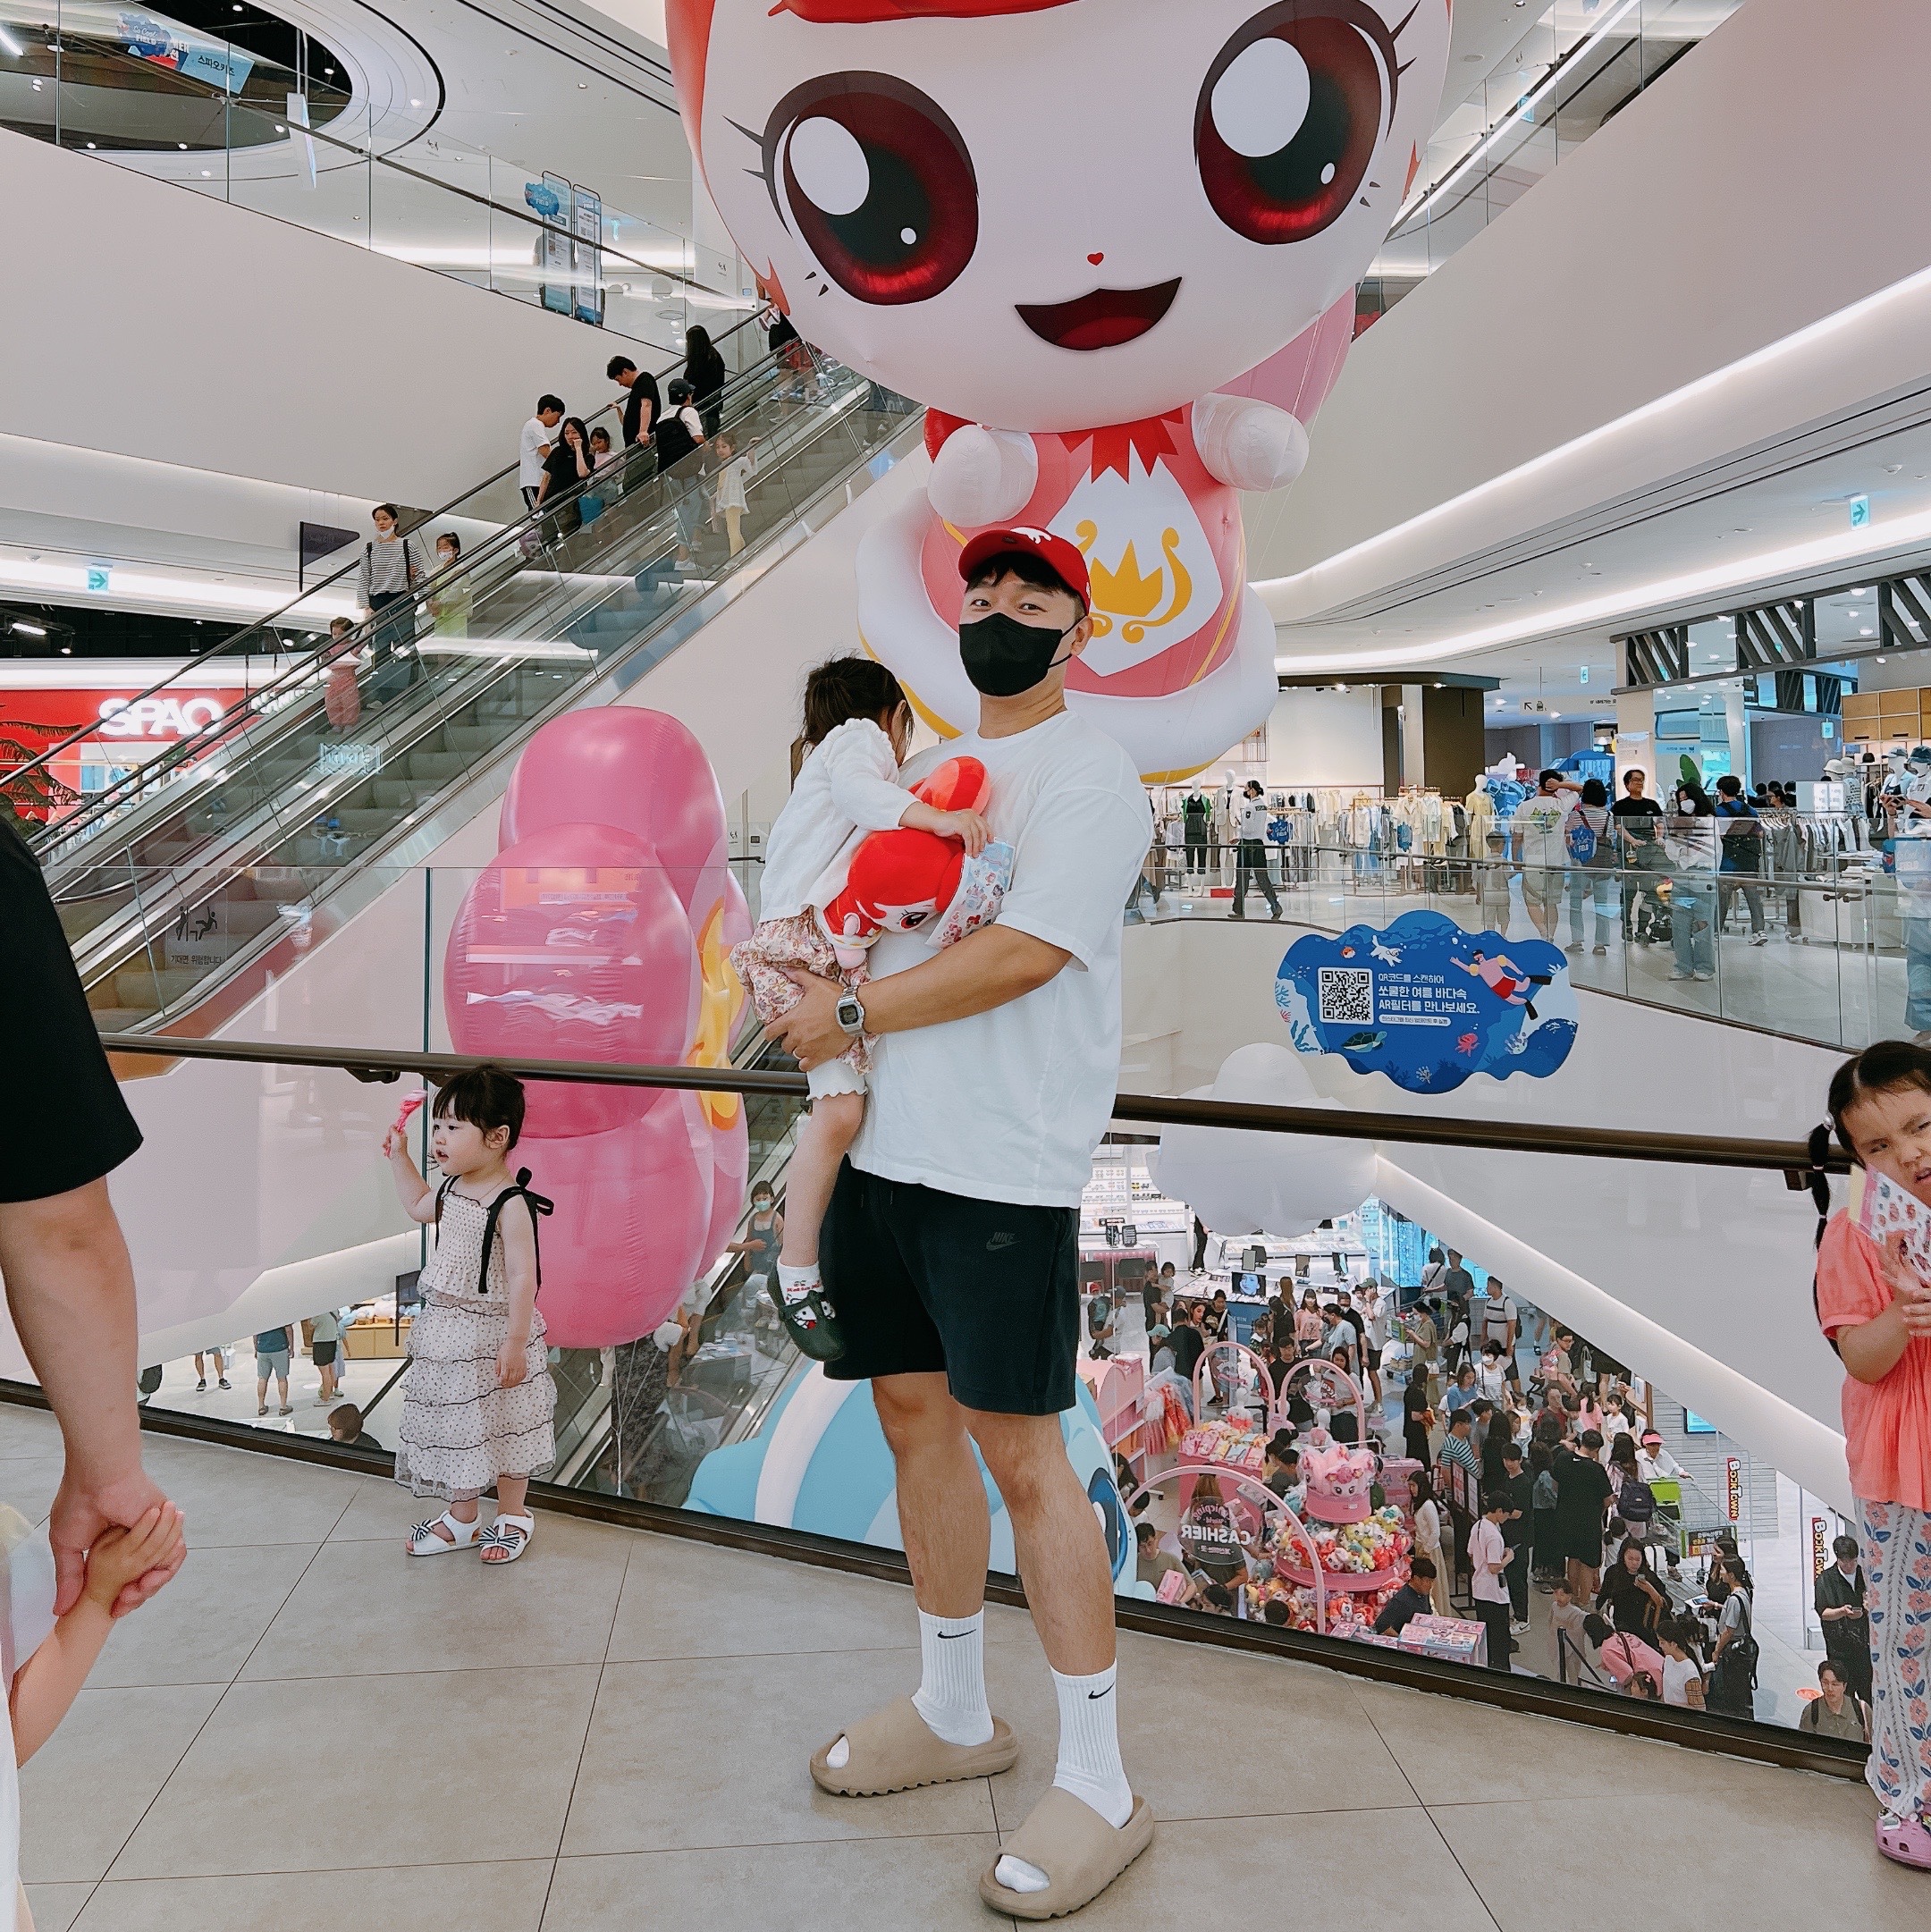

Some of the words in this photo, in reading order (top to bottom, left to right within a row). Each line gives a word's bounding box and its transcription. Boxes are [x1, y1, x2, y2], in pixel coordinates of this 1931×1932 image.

[98, 697, 223, 736] SPAO
[1412, 974, 1445, 984] 스캔하여
[1435, 988, 1467, 1000] 바다속
[1378, 999, 1421, 1011] AR필터를
